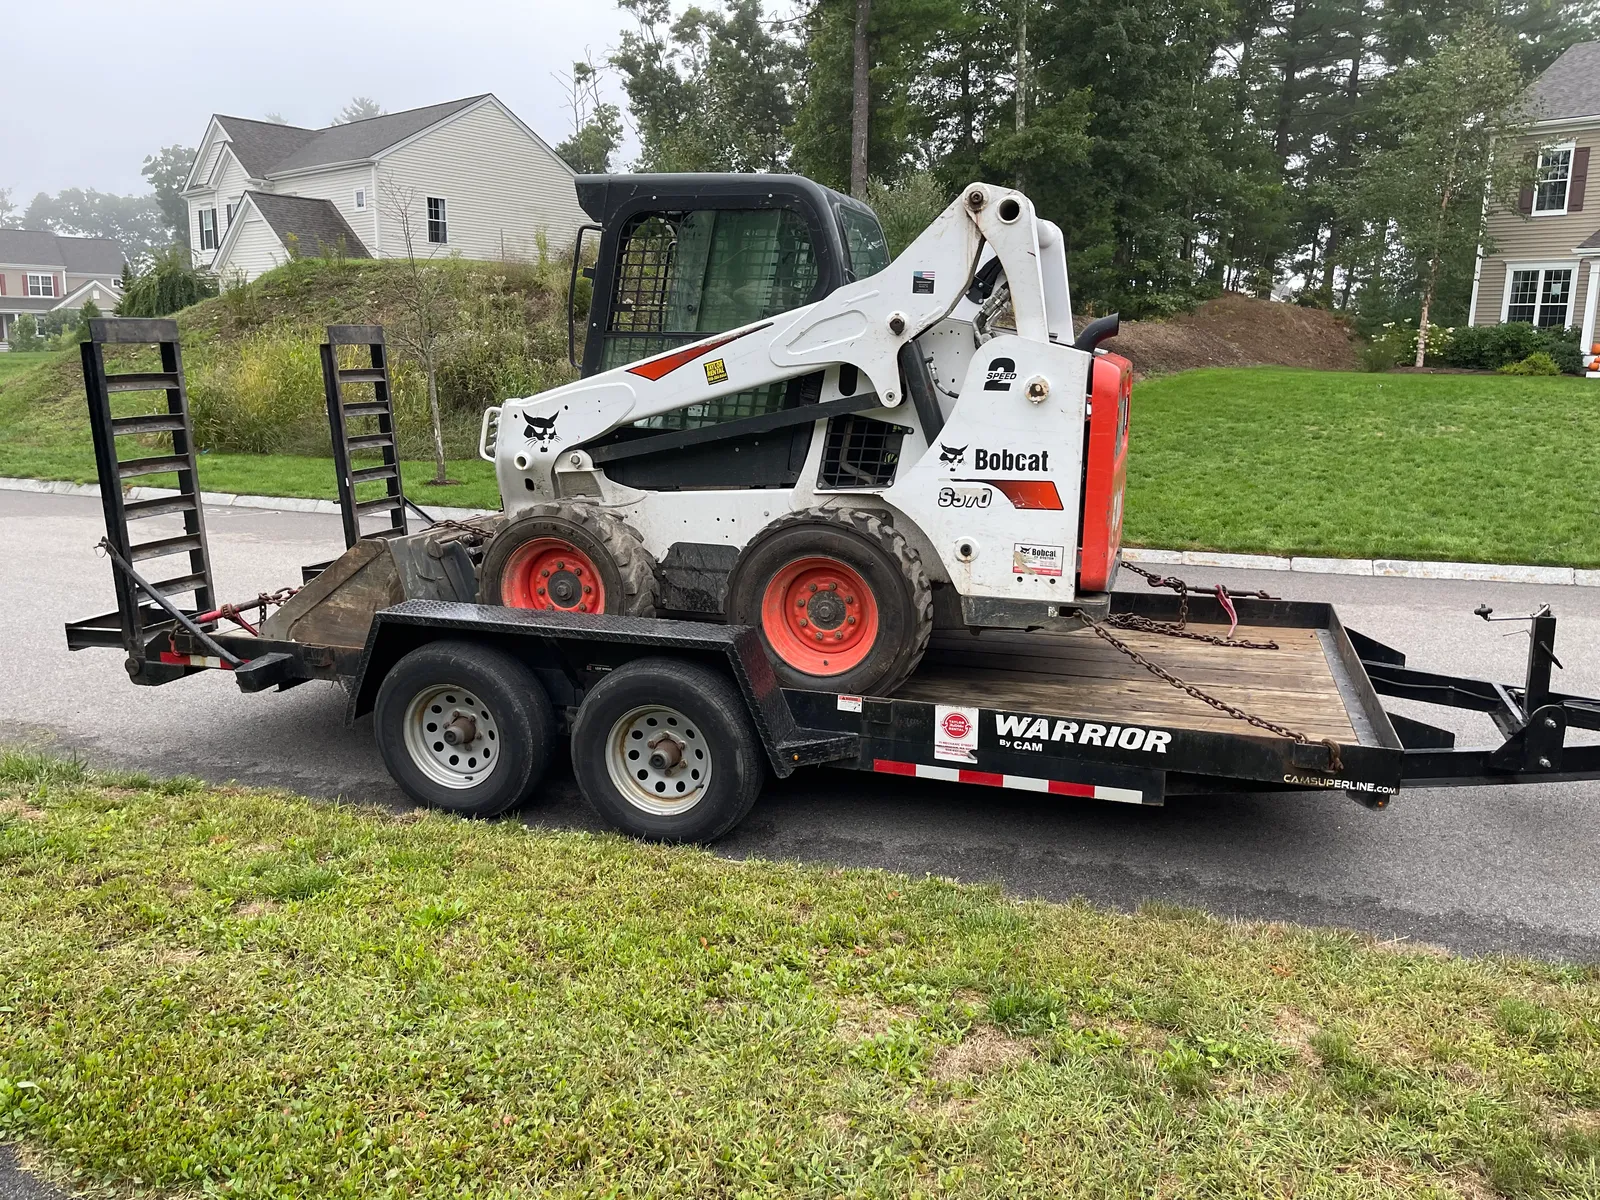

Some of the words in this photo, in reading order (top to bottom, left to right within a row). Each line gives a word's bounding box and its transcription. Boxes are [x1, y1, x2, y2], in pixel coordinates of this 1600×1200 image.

[984, 357, 1016, 391] 2
[986, 372, 1018, 380] SPEED
[975, 448, 1049, 472] Bobcat
[1032, 548, 1057, 557] Bobcat
[995, 714, 1173, 753] WARRIOR
[999, 738, 1012, 748] By
[1013, 740, 1043, 752] CAM
[1283, 774, 1396, 794] CAMSUPERLINE.COM
